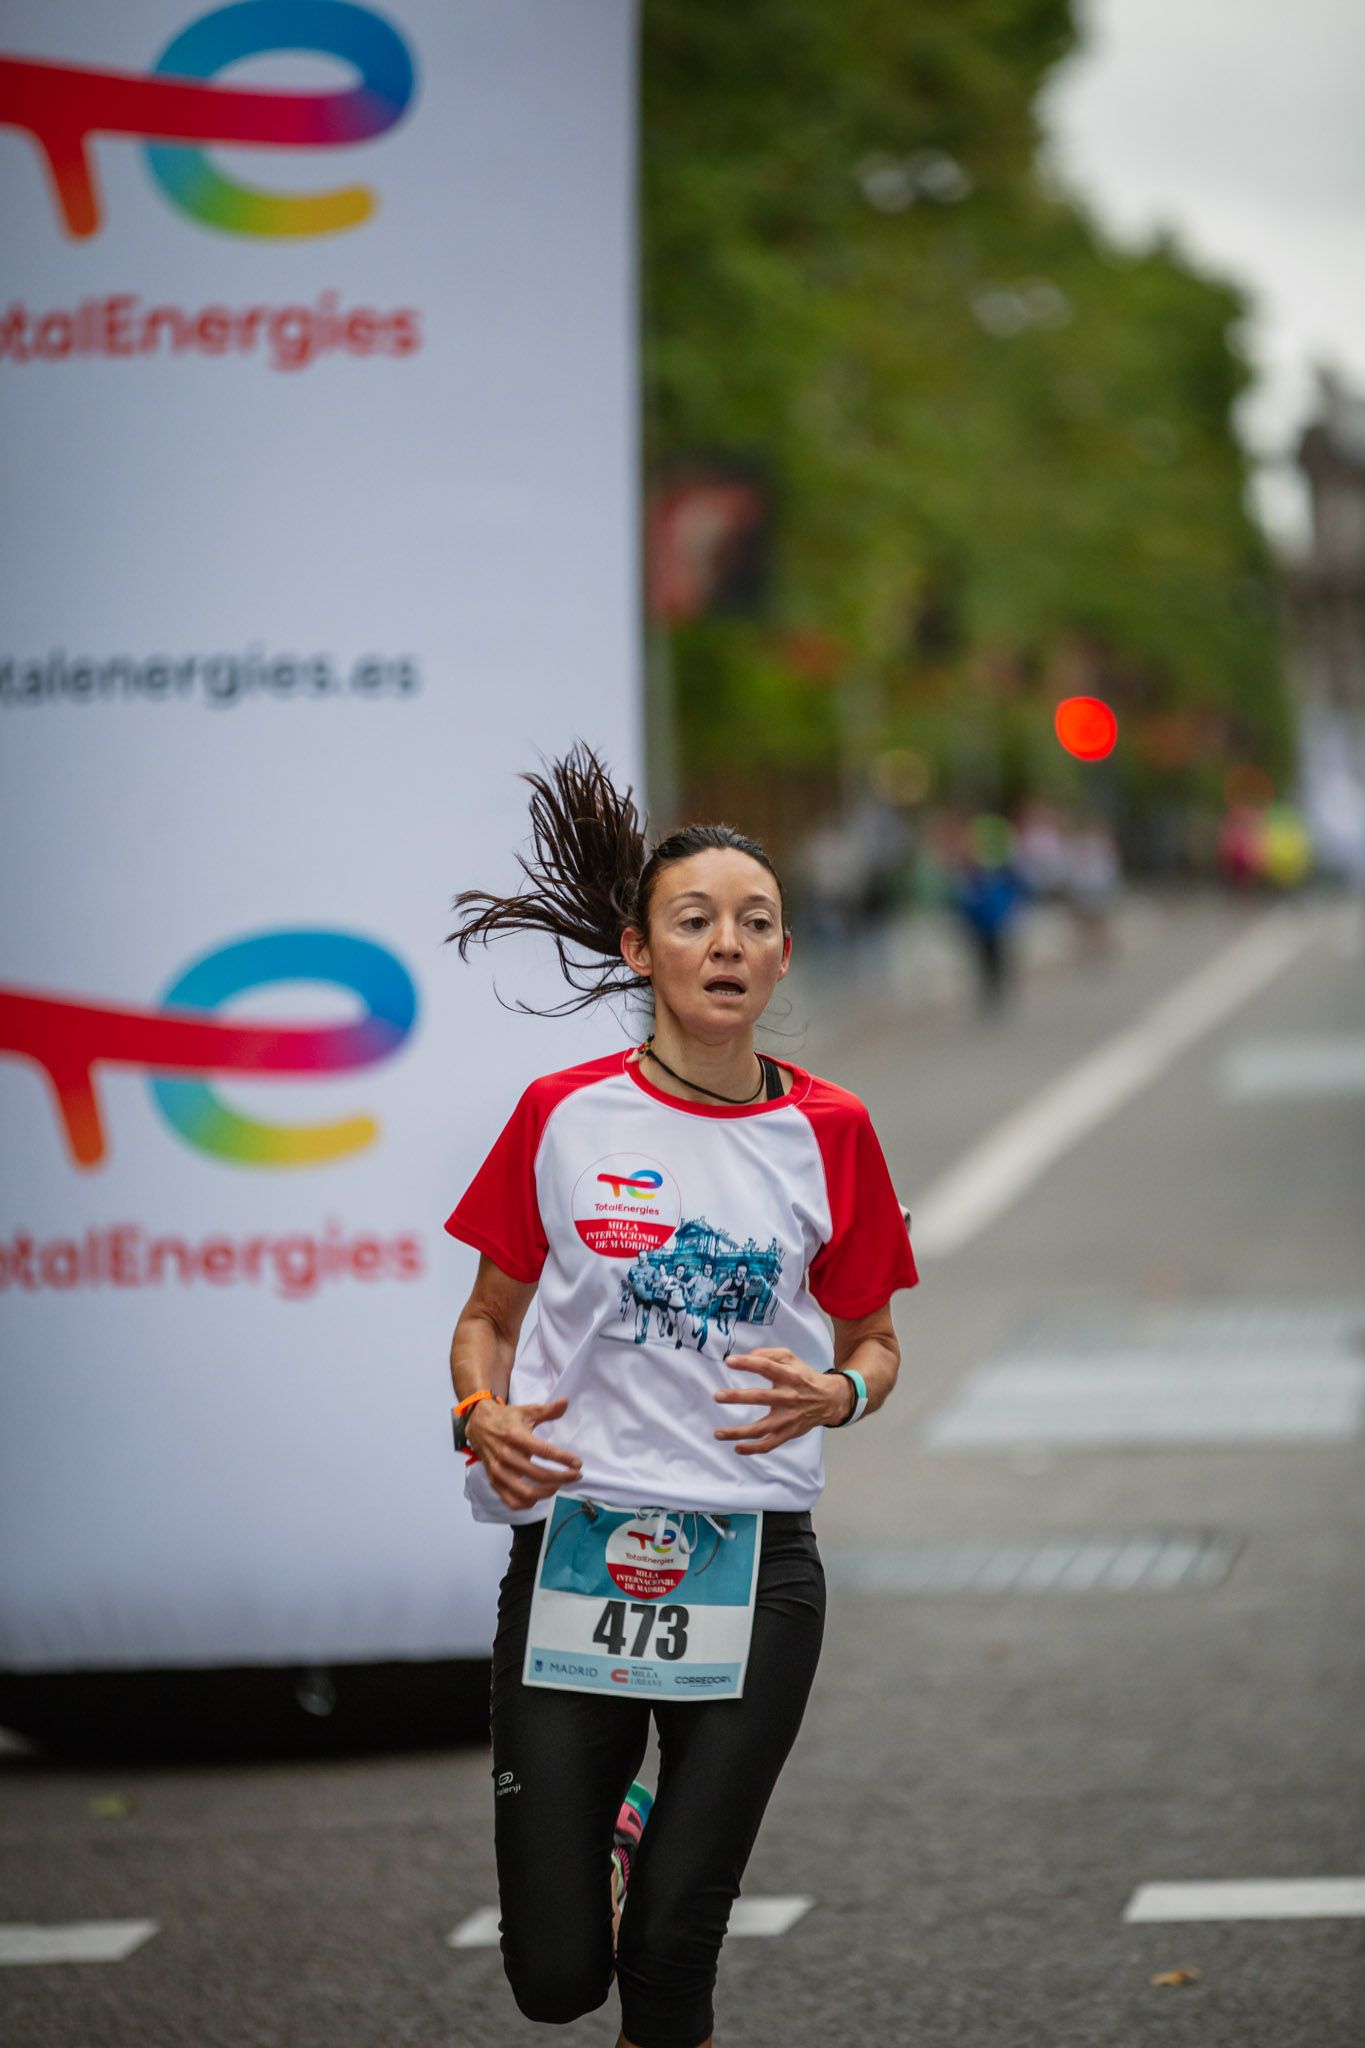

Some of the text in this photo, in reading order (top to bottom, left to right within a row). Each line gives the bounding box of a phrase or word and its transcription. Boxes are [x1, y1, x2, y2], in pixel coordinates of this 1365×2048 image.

[0, 288, 423, 373] talEnergies
[594, 1203, 660, 1216] TotalEnergies
[607, 1221, 638, 1231] MILLA
[586, 1231, 661, 1245] INTERNACIONAL
[595, 1240, 649, 1251] DE MADRID
[625, 1552, 674, 1565] TotalEnergies
[635, 1569, 659, 1578] MILLA
[624, 1582, 666, 1594] DE MADRID
[592, 1600, 689, 1661] 473
[550, 1663, 598, 1678] MADRID
